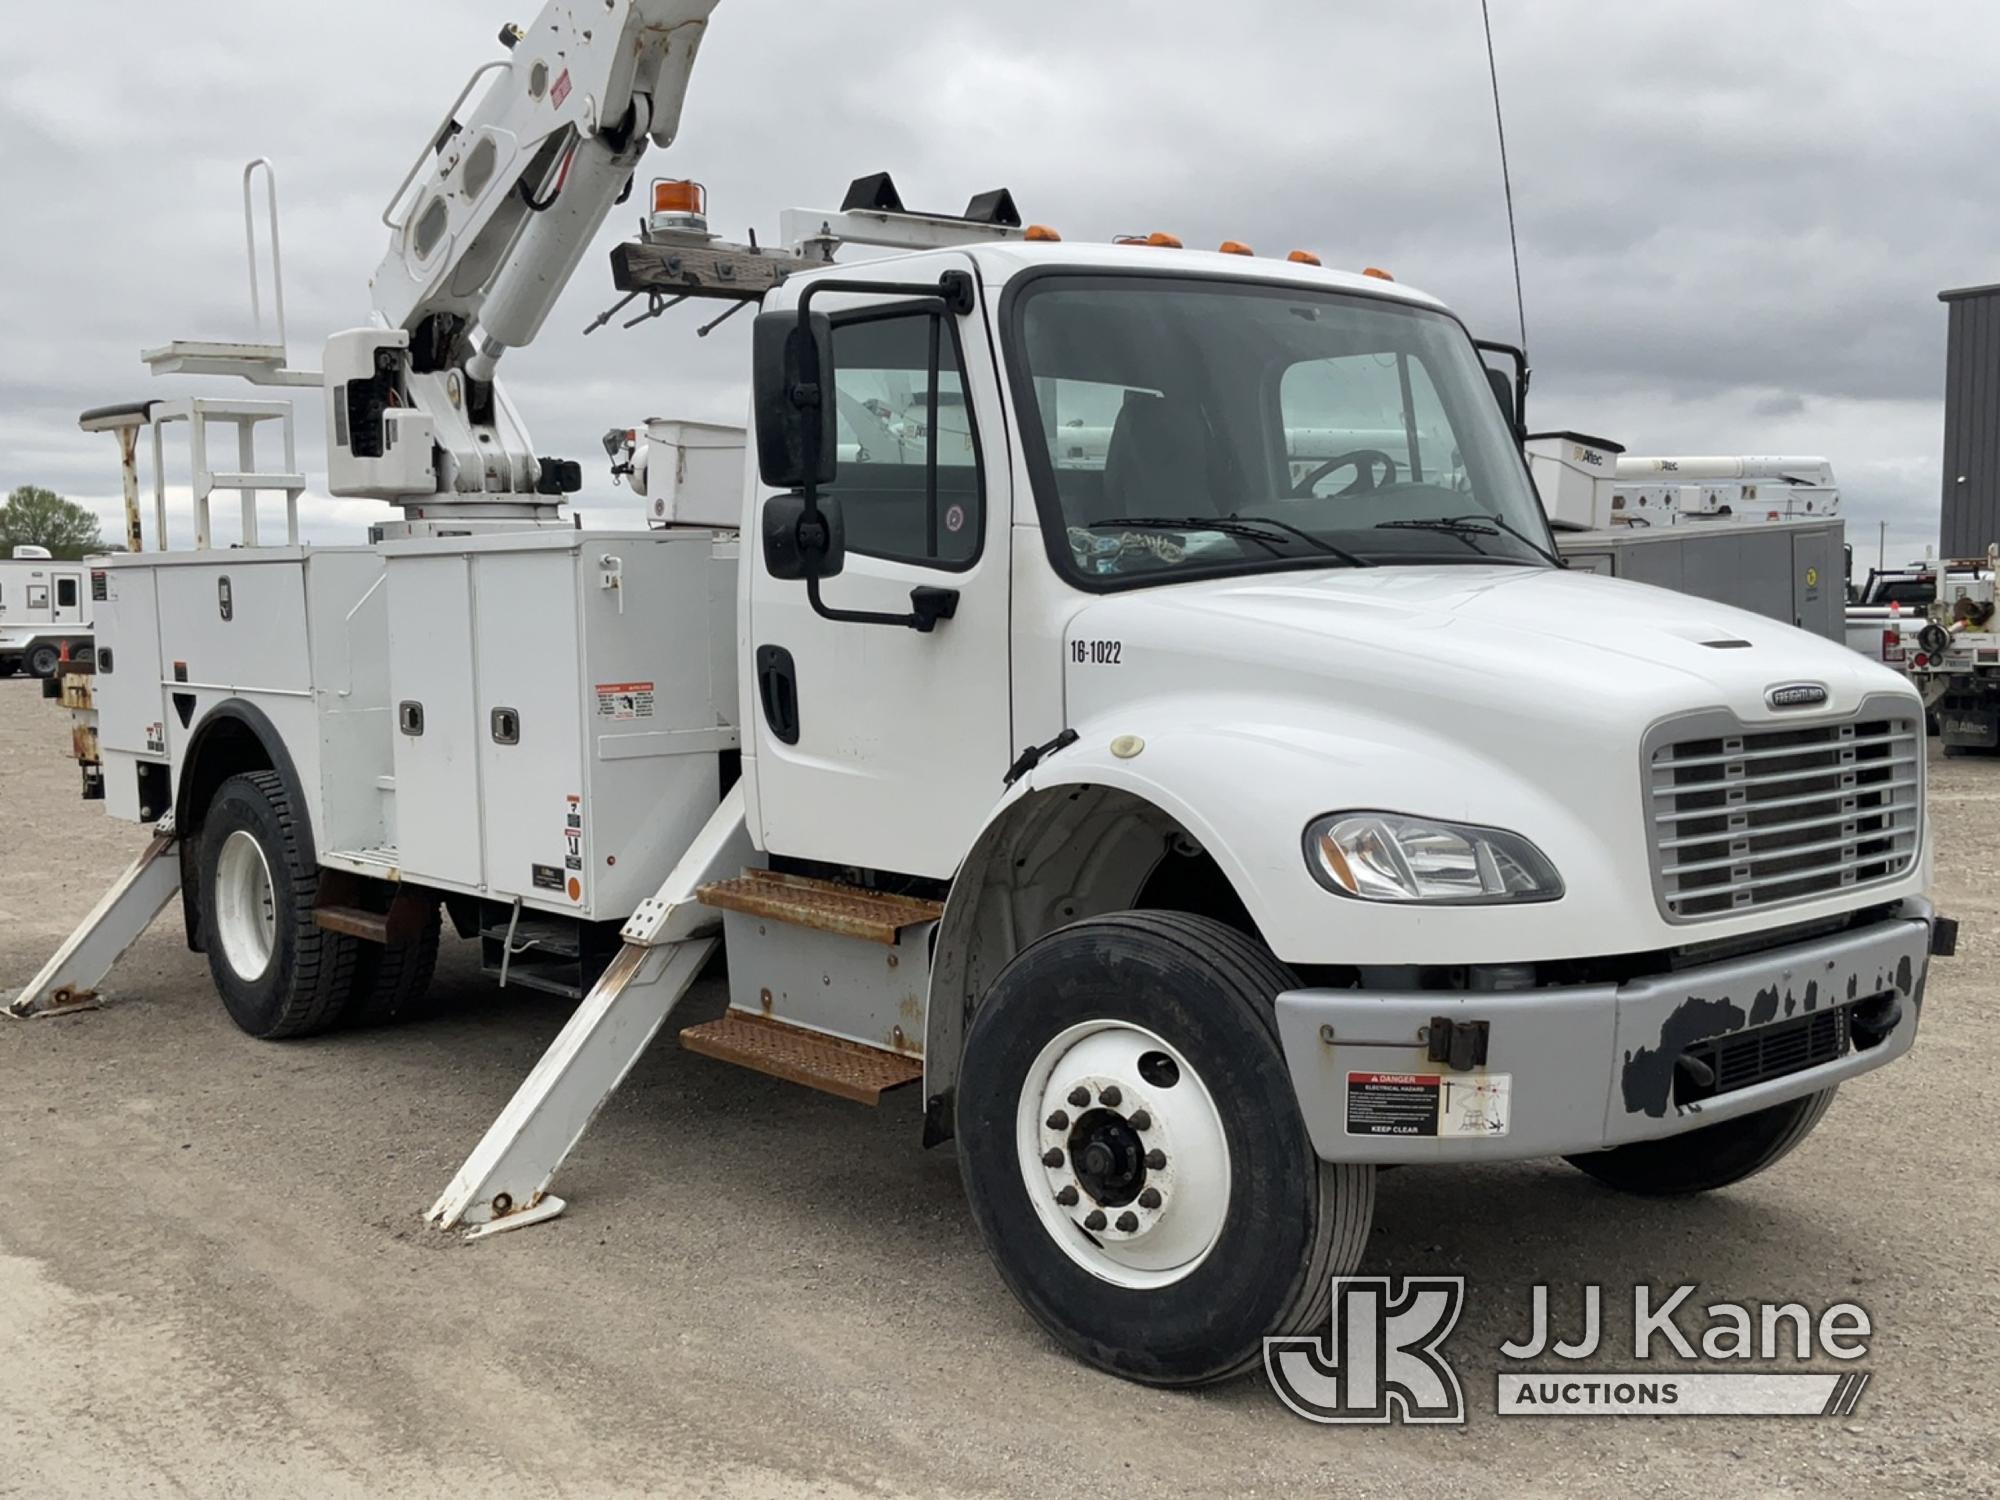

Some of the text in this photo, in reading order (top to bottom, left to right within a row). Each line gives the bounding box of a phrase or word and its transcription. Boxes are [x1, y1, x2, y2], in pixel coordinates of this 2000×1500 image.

[1582, 450, 1603, 467] Altec
[1071, 640, 1122, 664] 16-1022
[1960, 720, 1989, 735] Altec
[1379, 1076, 1416, 1084] DANGER
[1392, 1126, 1418, 1134] CLEAR
